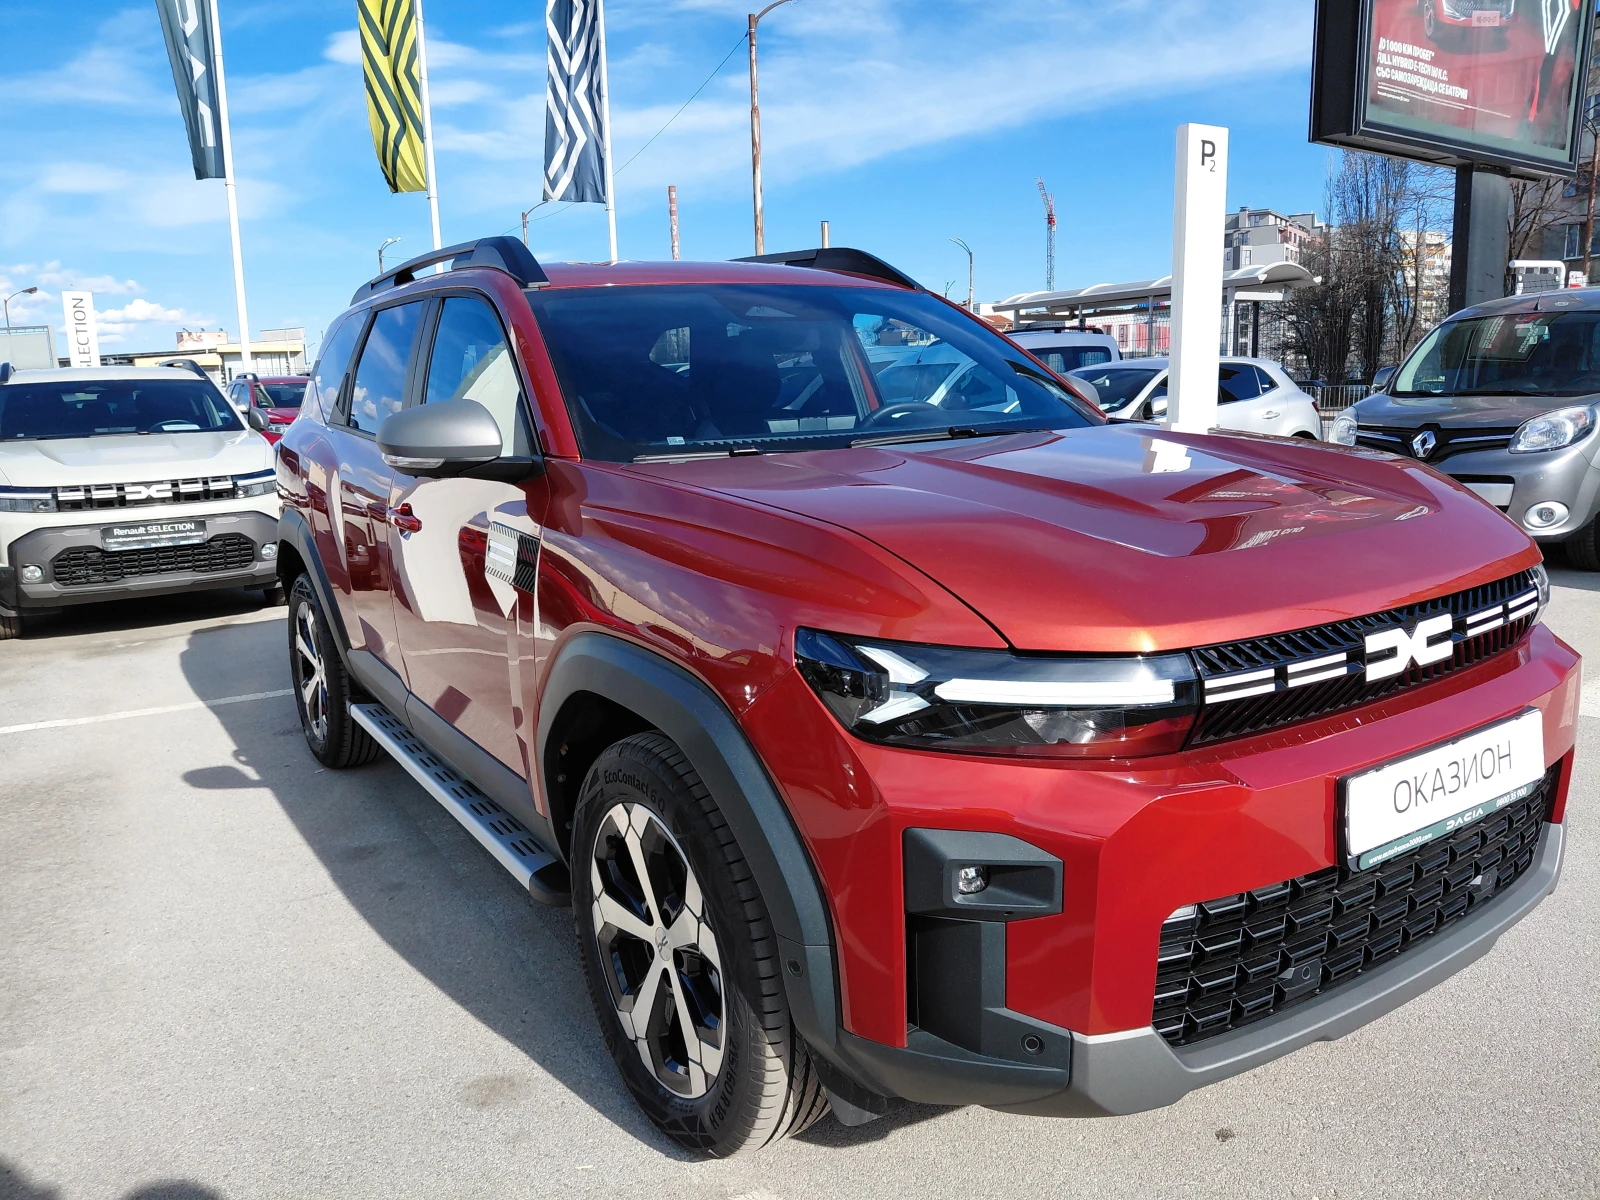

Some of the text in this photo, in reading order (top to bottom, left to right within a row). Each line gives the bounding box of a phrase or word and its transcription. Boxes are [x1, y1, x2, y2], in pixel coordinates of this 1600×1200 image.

[1377, 52, 1392, 65] FULL
[1392, 55, 1414, 70] HYBRID
[1376, 66, 1391, 79] СЪС
[1439, 83, 1446, 94] СЕ
[72, 297, 93, 368] LECTION
[113, 522, 195, 536] Renault SELECTION
[1393, 740, 1512, 814] ОКАЗИОН
[603, 769, 665, 817] EcoContact 6 Q
[1445, 807, 1484, 831] DACIA
